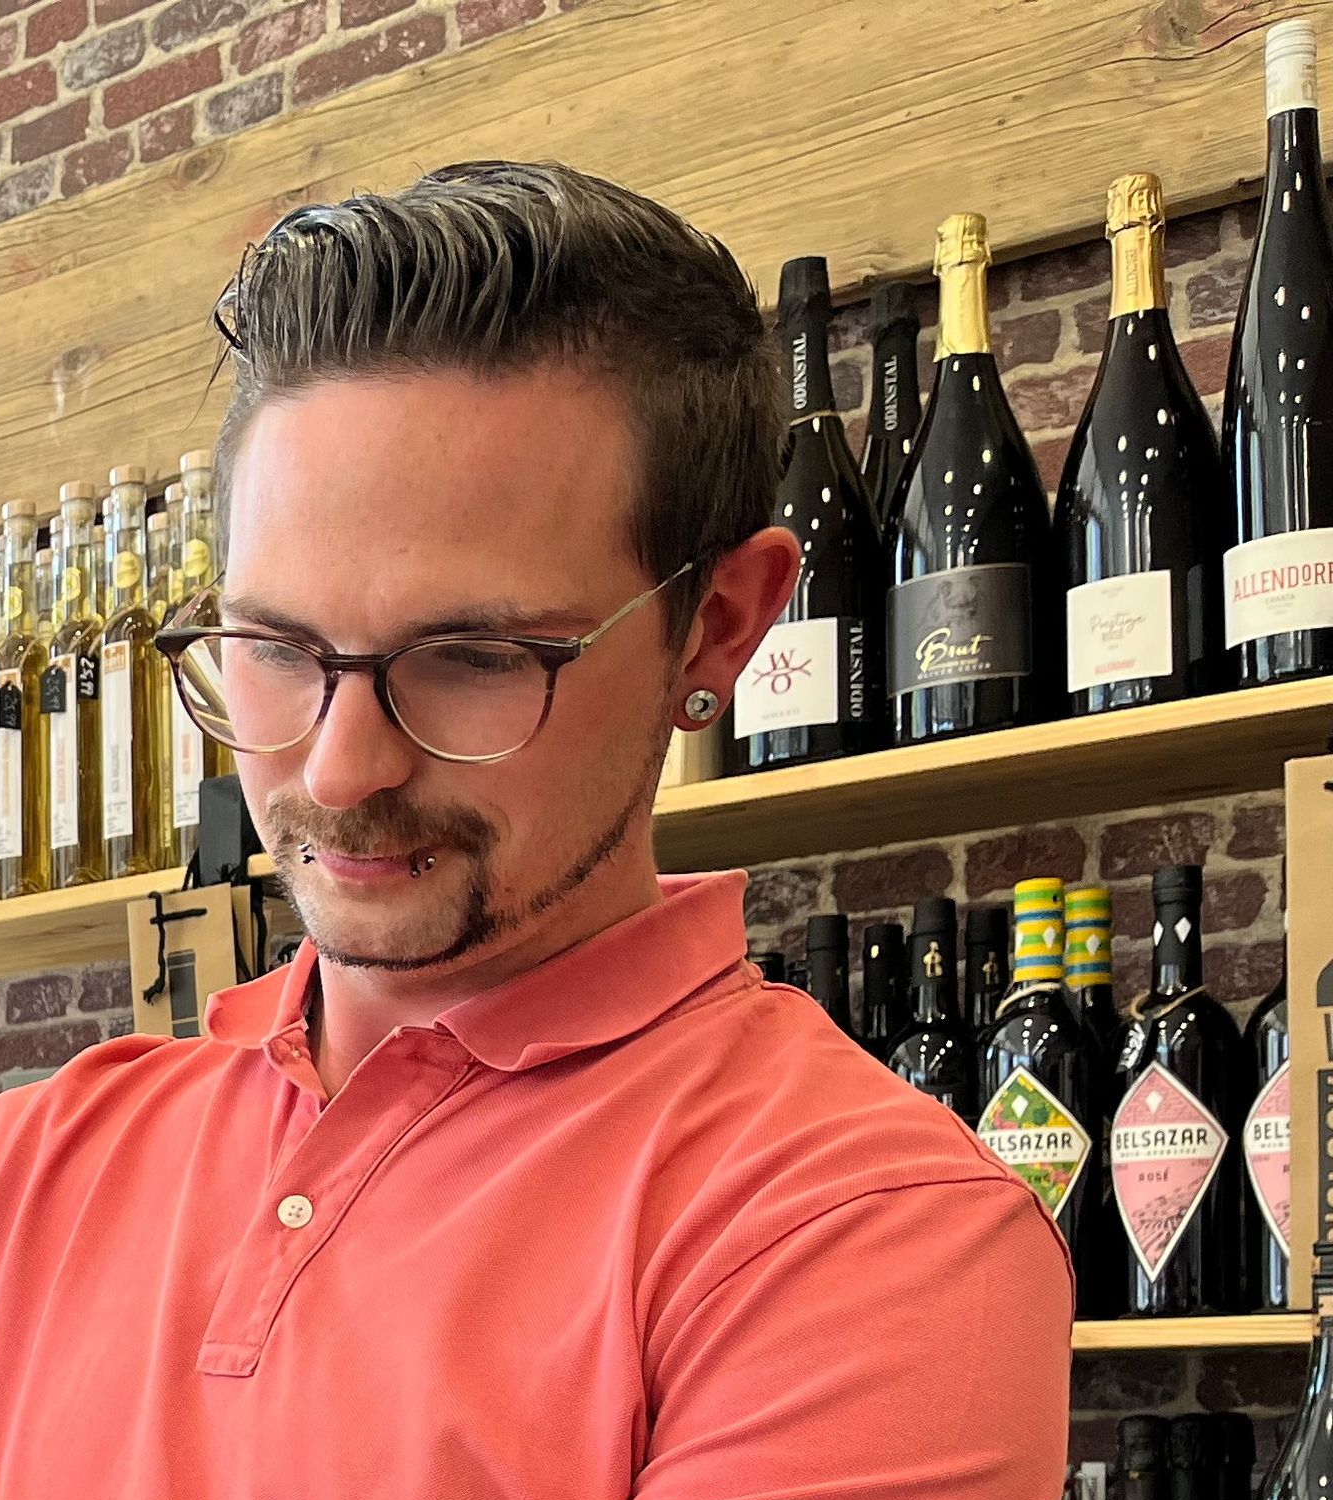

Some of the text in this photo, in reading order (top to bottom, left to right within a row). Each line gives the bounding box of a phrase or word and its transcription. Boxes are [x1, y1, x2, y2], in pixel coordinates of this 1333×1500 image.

[792, 331, 808, 410] ODINSTAL
[884, 354, 899, 431] ODINSTAL
[849, 619, 865, 718] ODINSTAL
[915, 627, 993, 673] Brut
[986, 1132, 1072, 1153] ELSAZAR
[1116, 1128, 1208, 1152] BELSAZAR
